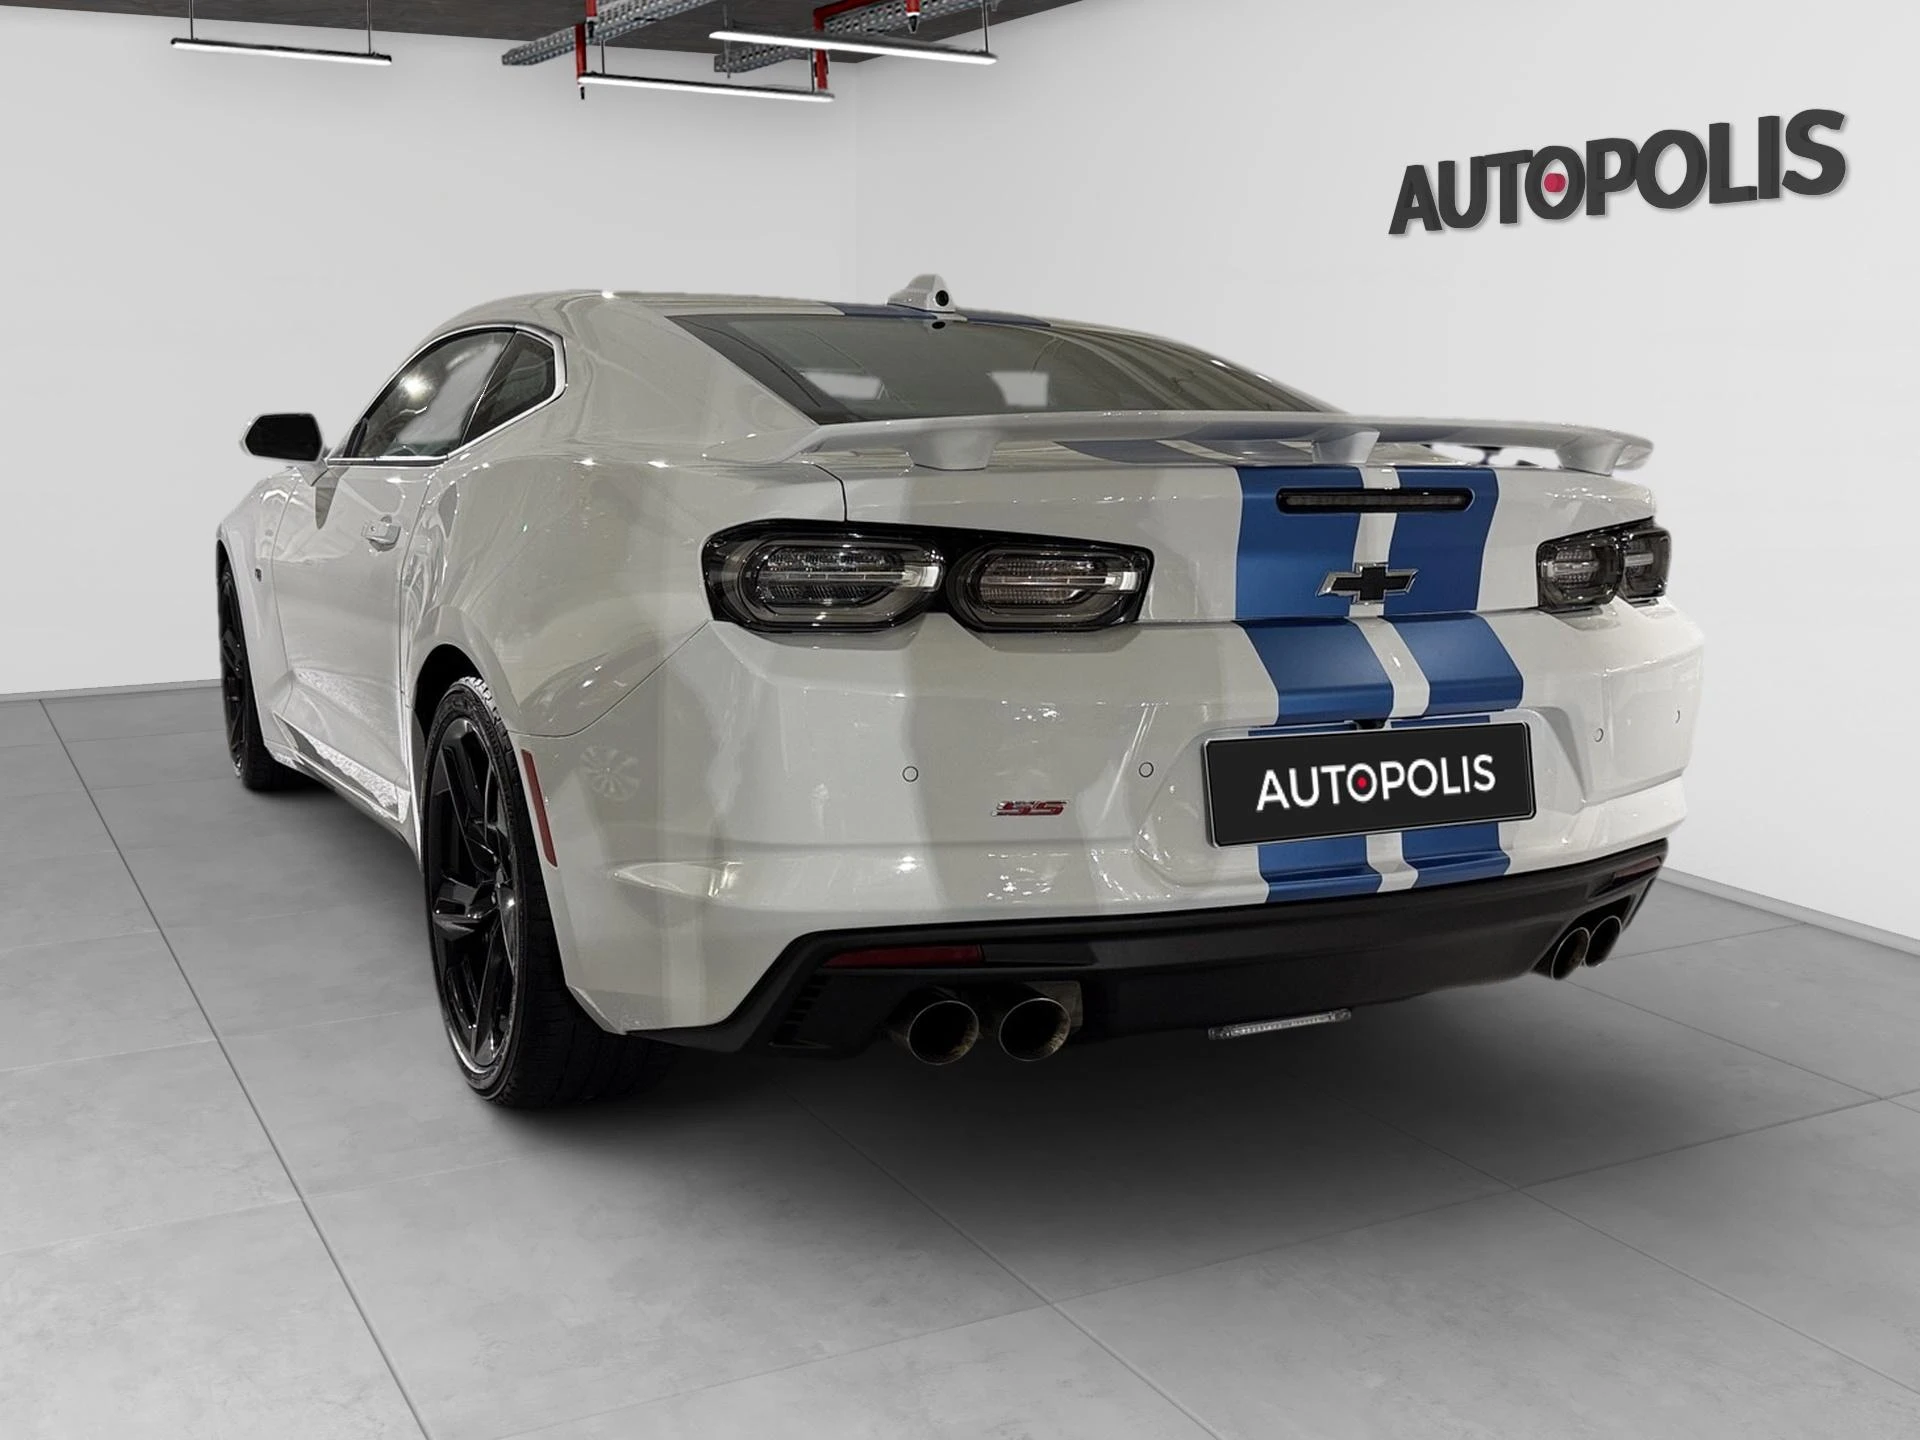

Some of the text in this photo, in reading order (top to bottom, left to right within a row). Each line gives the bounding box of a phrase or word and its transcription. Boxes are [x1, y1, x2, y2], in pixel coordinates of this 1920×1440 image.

[1388, 108, 1846, 235] AUTOPOLIS
[992, 800, 1067, 816] SS
[1256, 754, 1496, 812] AUTOPOLIS
